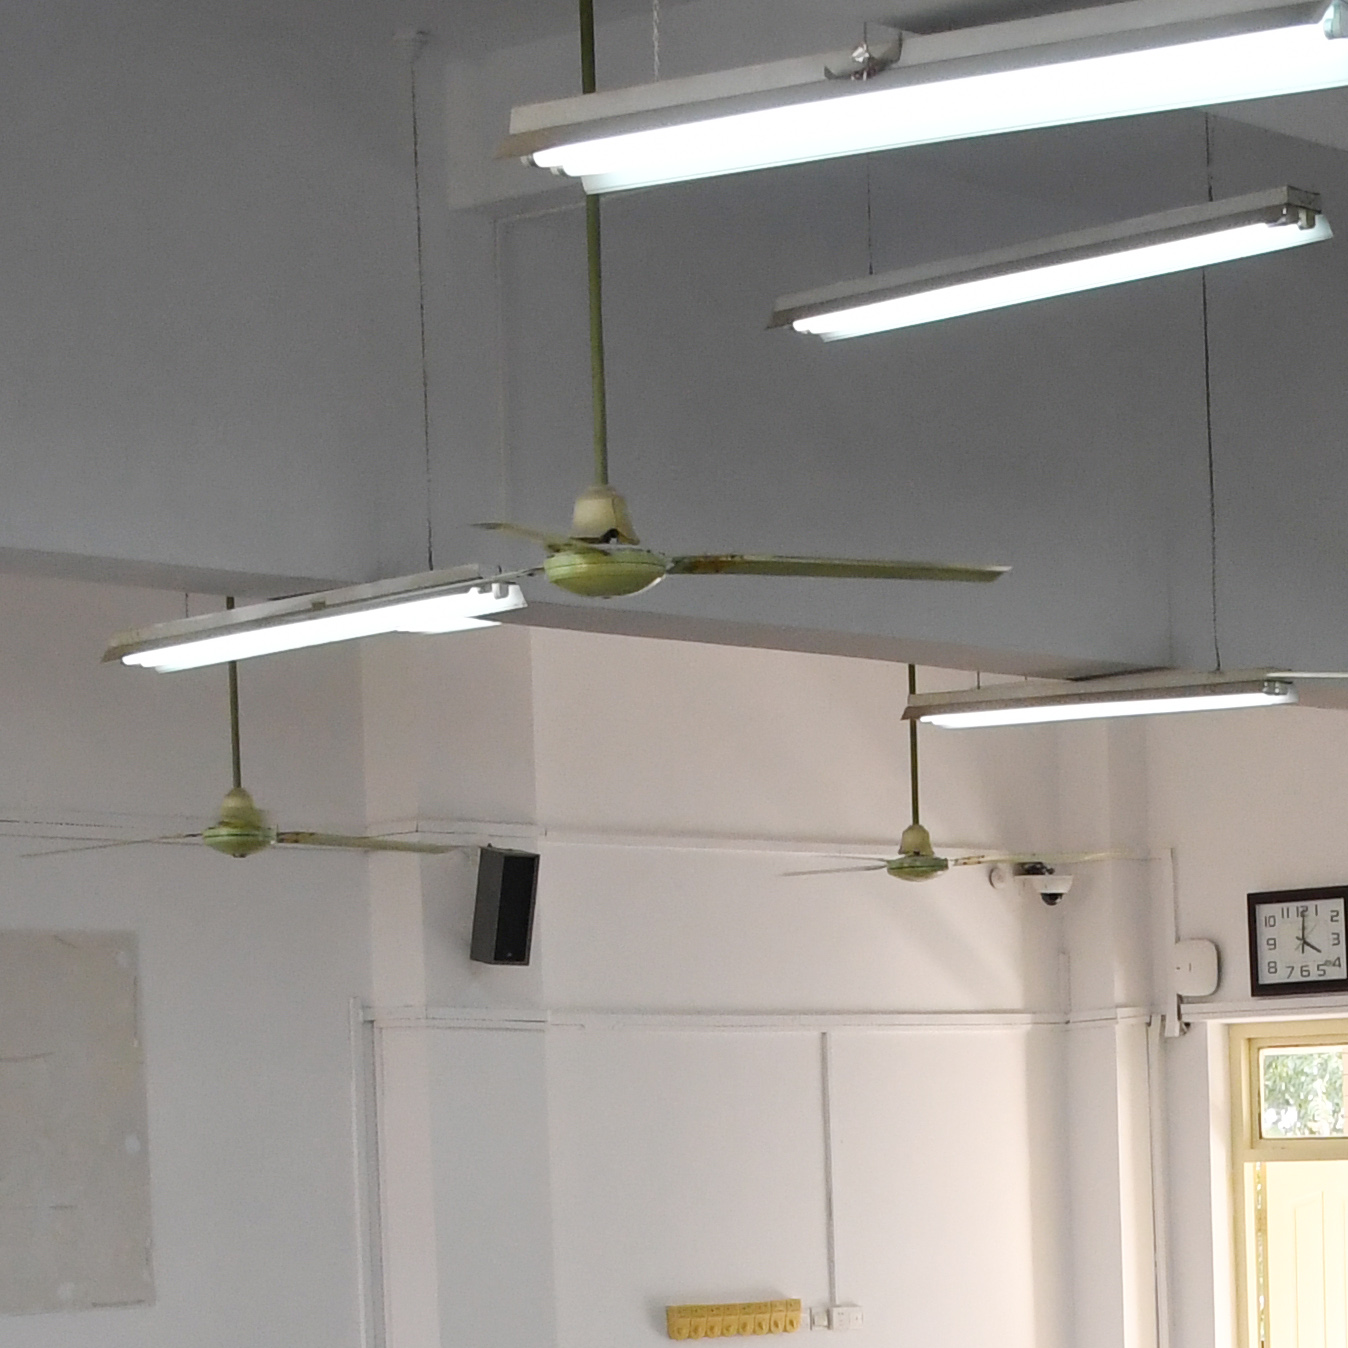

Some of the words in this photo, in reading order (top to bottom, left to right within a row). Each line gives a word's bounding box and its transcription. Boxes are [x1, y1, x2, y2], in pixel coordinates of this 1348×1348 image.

[1281, 907, 1290, 919] 11
[1296, 905, 1309, 918] 12
[1314, 904, 1319, 917] 1
[1329, 909, 1340, 923] 2
[1264, 915, 1276, 928] 10
[1266, 937, 1277, 951] 9
[1331, 932, 1341, 946] 3
[1267, 961, 1278, 975] 8
[1332, 957, 1342, 968] 4
[1285, 965, 1295, 979] 7
[1300, 965, 1311, 978] 6
[1316, 963, 1327, 977] 5
